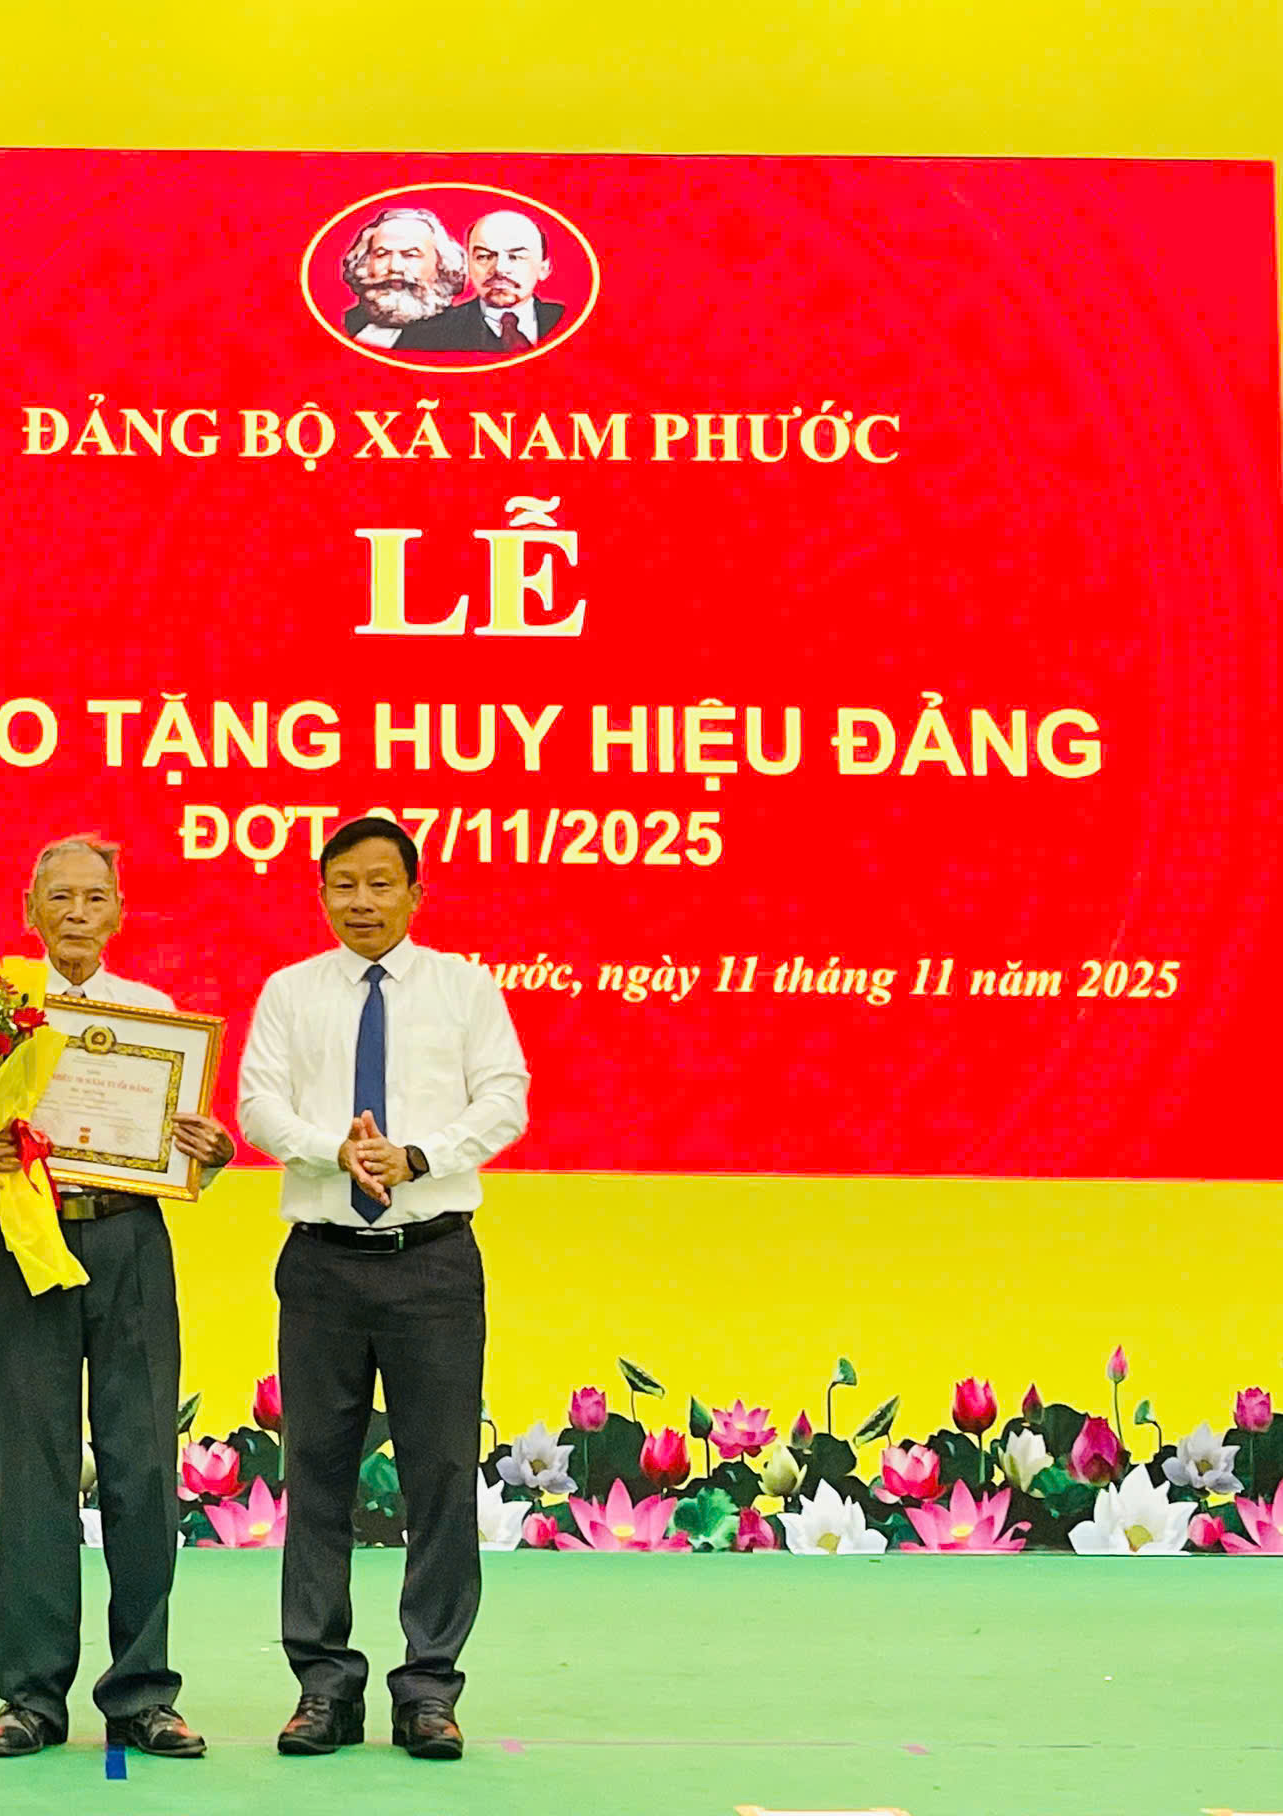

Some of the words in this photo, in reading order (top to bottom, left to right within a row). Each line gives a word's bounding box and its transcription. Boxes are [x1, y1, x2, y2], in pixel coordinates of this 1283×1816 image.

[22, 394, 220, 457] ĐẢNG
[239, 402, 335, 471] BỘ
[355, 399, 451, 458] XÃ
[469, 412, 630, 460] NAM
[651, 400, 899, 463] PHƯỚC
[355, 496, 586, 636] LỄ
[87, 693, 340, 785] TẶNG
[375, 703, 563, 771] HUY
[592, 698, 801, 791] HIỆU
[831, 692, 1101, 778] ĐẢNG
[178, 804, 339, 874] ĐỢT
[365, 807, 722, 866] 7/11/2025
[439, 952, 583, 998] ước,
[598, 955, 700, 1002] ngày
[716, 956, 757, 992] 11
[773, 957, 897, 1005] tháng
[911, 959, 953, 995] 11
[970, 960, 1061, 996] năm
[1077, 960, 1180, 998] 2025
